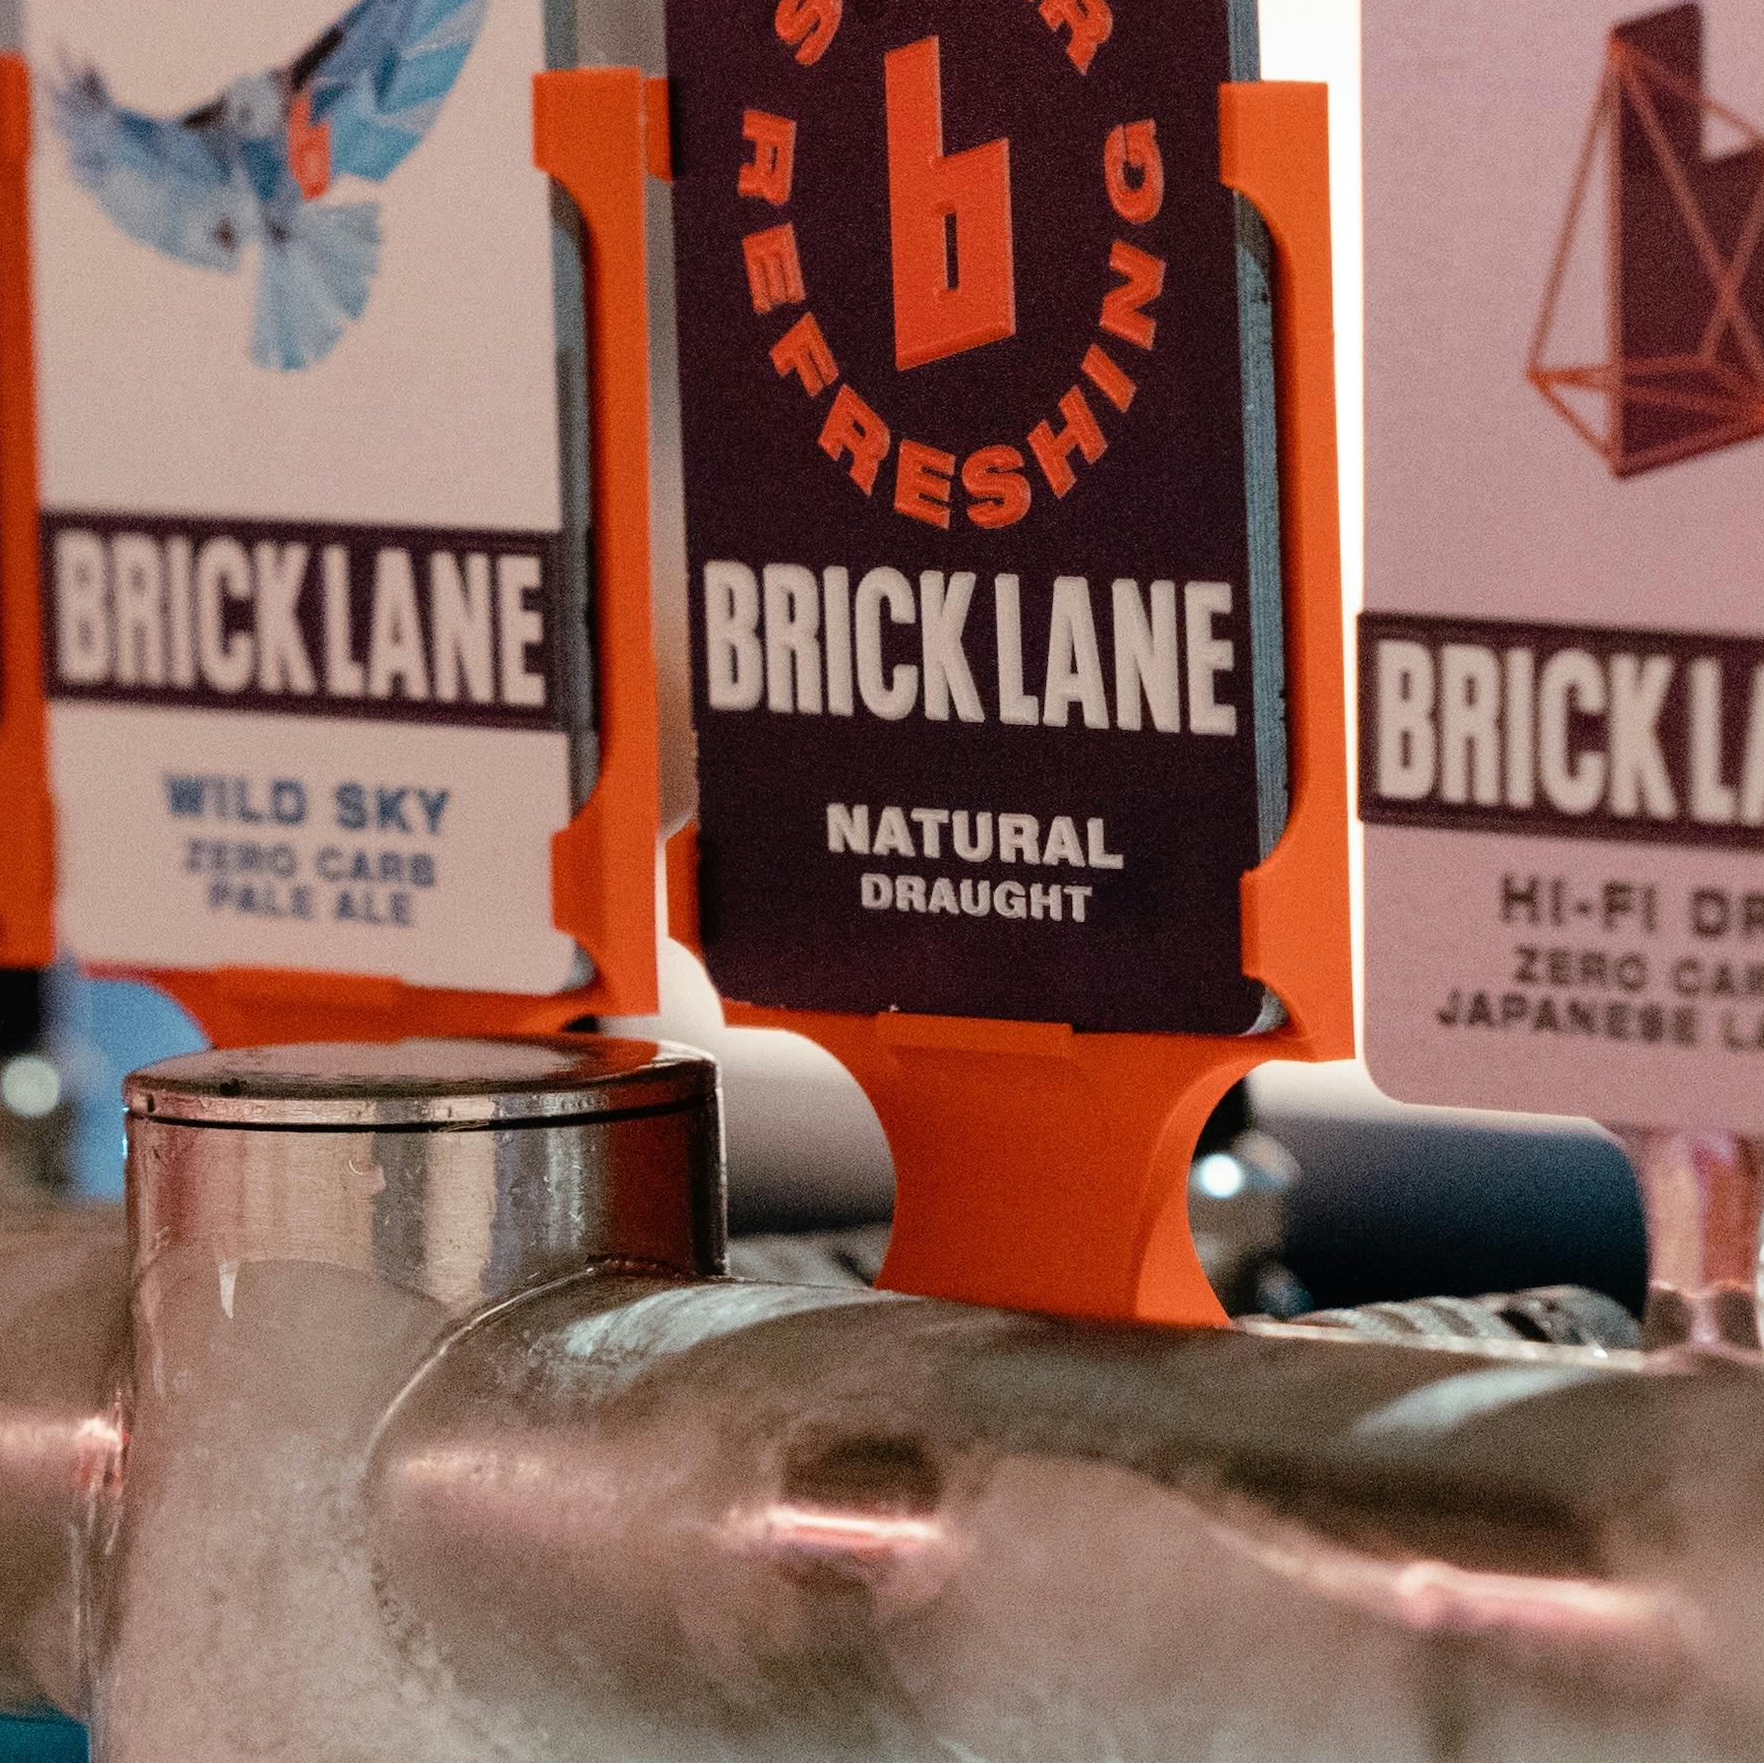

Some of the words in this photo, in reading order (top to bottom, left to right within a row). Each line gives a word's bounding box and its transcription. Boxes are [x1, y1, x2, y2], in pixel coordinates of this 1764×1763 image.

[885, 35, 1016, 371] b
[738, 110, 1166, 529] REFRESHING
[162, 771, 307, 827] WILD
[332, 782, 451, 837] SKY
[185, 837, 297, 877] ZERO
[315, 847, 436, 887] CARB
[826, 803, 1124, 870] NATURAL
[207, 880, 313, 922] PALE
[335, 888, 414, 928] ALE
[860, 873, 1093, 923] DRAUGHT
[1498, 874, 1659, 933] HI-FI
[1514, 945, 1648, 993] ZERO
[1435, 989, 1701, 1048] JAPANESE
